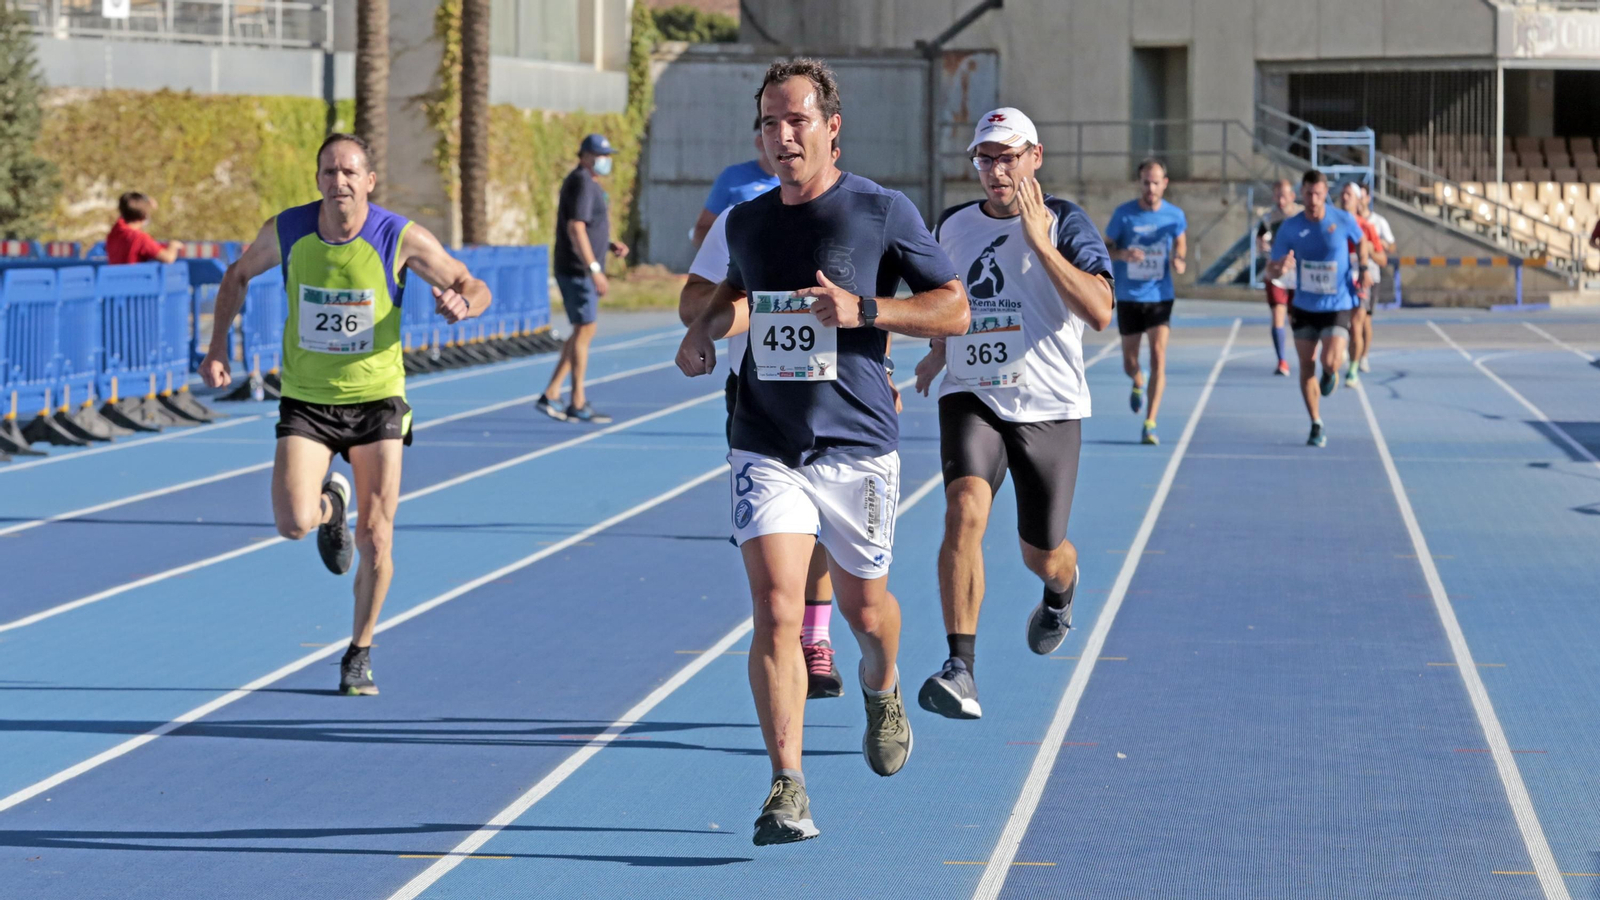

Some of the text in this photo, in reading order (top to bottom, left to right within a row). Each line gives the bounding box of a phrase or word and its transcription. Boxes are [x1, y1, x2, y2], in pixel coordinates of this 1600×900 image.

[998, 299, 1022, 309] Kilos
[315, 312, 358, 332] 236
[763, 325, 815, 351] 439
[966, 341, 1008, 366] 363
